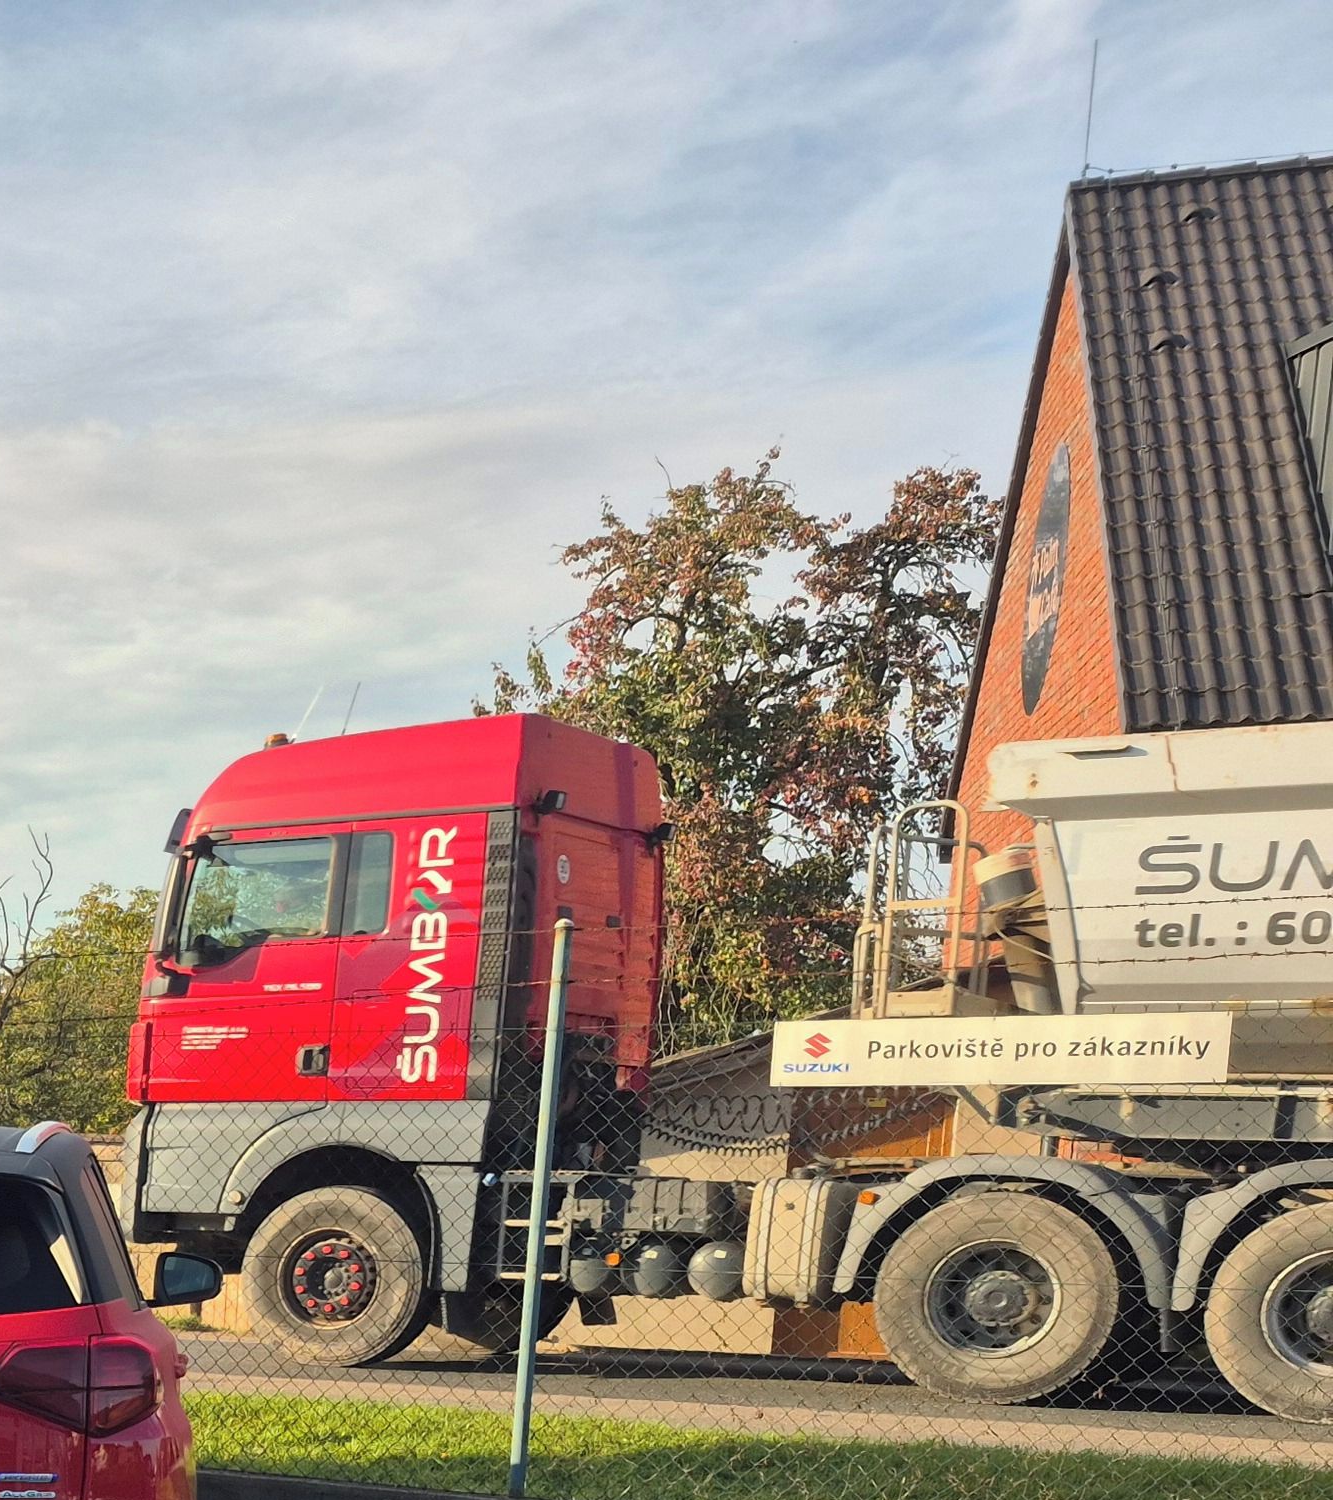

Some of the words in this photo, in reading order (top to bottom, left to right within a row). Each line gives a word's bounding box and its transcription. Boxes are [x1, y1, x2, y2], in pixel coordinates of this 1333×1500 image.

[867, 1037, 1004, 1060] Parkoviště
[1014, 1041, 1057, 1061] pro
[1067, 1035, 1211, 1060] zákazníky
[783, 1063, 850, 1073] SUZUKI
